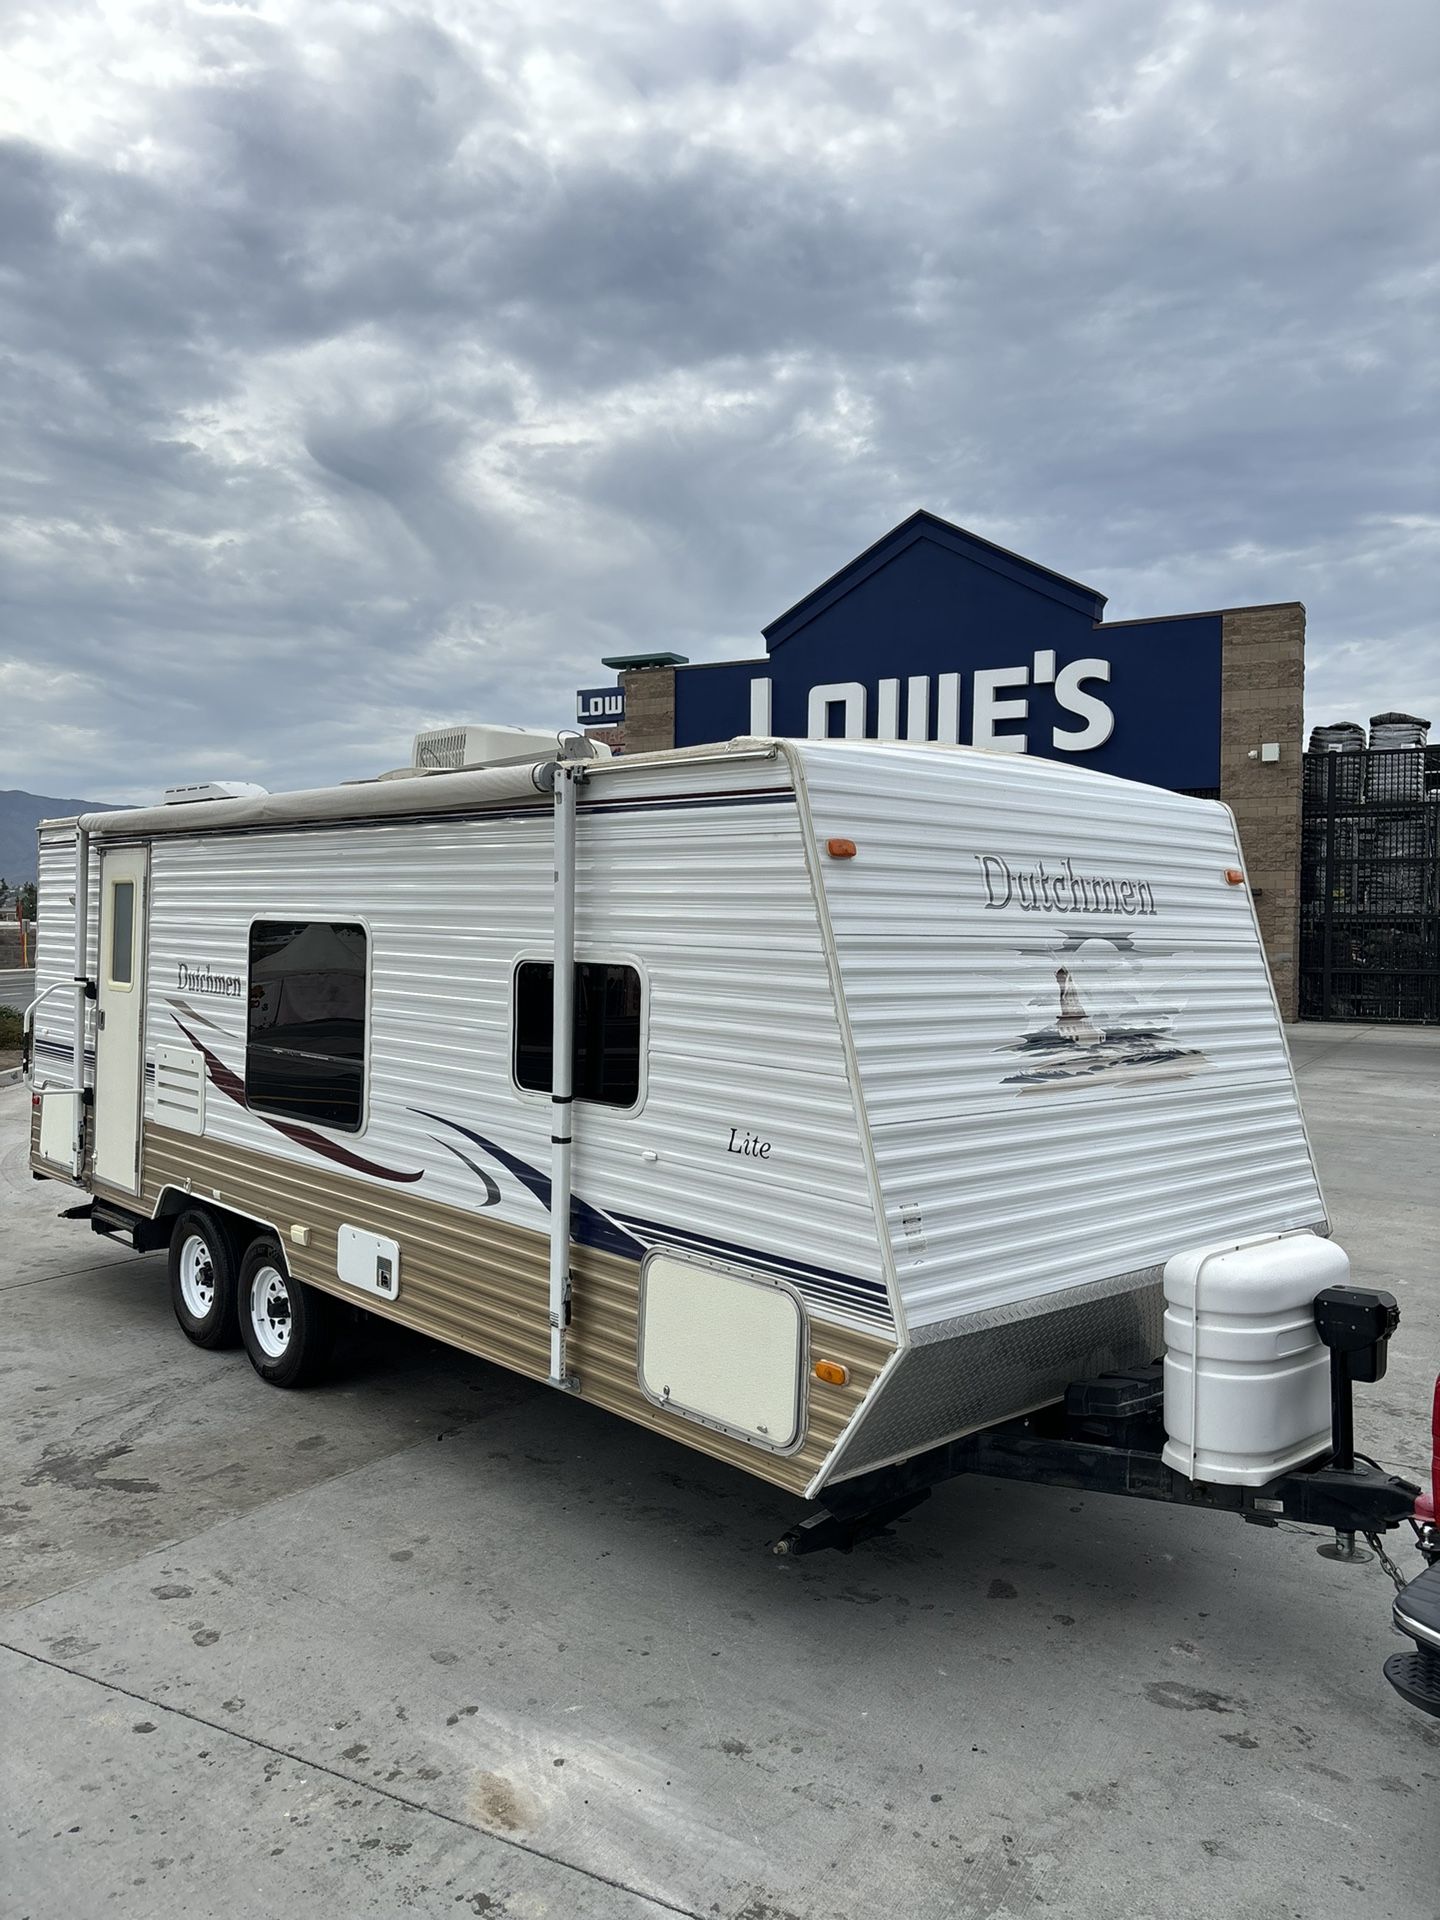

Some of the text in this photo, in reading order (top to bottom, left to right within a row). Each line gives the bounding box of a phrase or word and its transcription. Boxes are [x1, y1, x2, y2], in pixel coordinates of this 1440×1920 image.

[974, 854, 1158, 916] Dutchmen
[176, 962, 242, 997] Dutchmen
[727, 1127, 772, 1160] Lite
